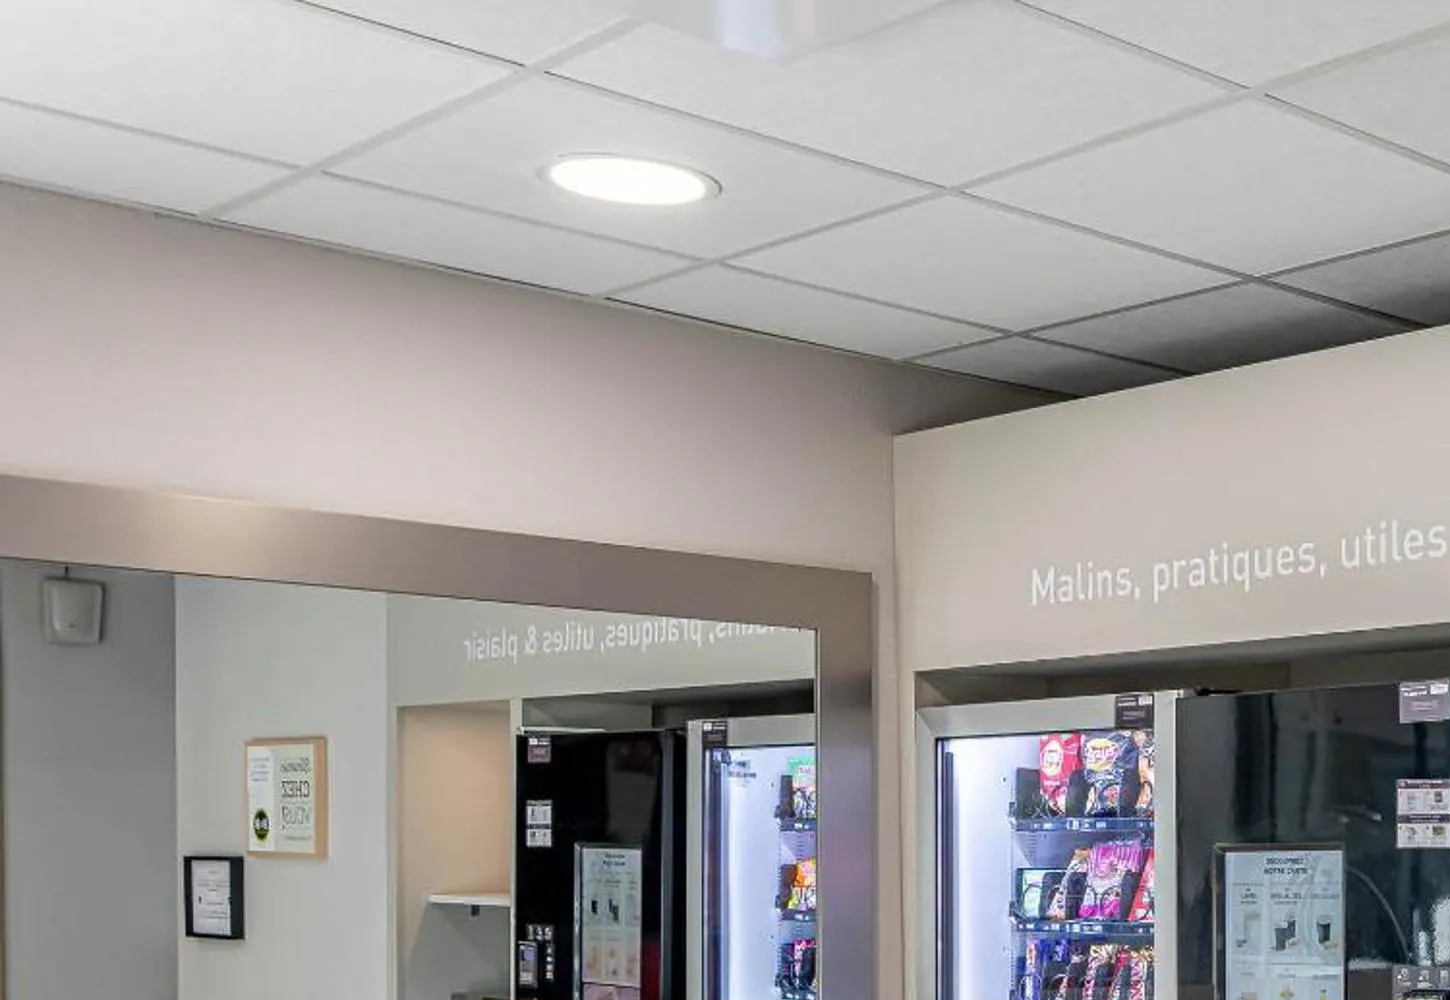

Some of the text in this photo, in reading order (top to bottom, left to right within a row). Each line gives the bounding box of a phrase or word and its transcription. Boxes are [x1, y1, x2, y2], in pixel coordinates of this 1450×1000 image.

[1031, 561, 1141, 604] Malins,
[1153, 542, 1327, 603] pratiques,
[1341, 519, 1448, 568] utiles
